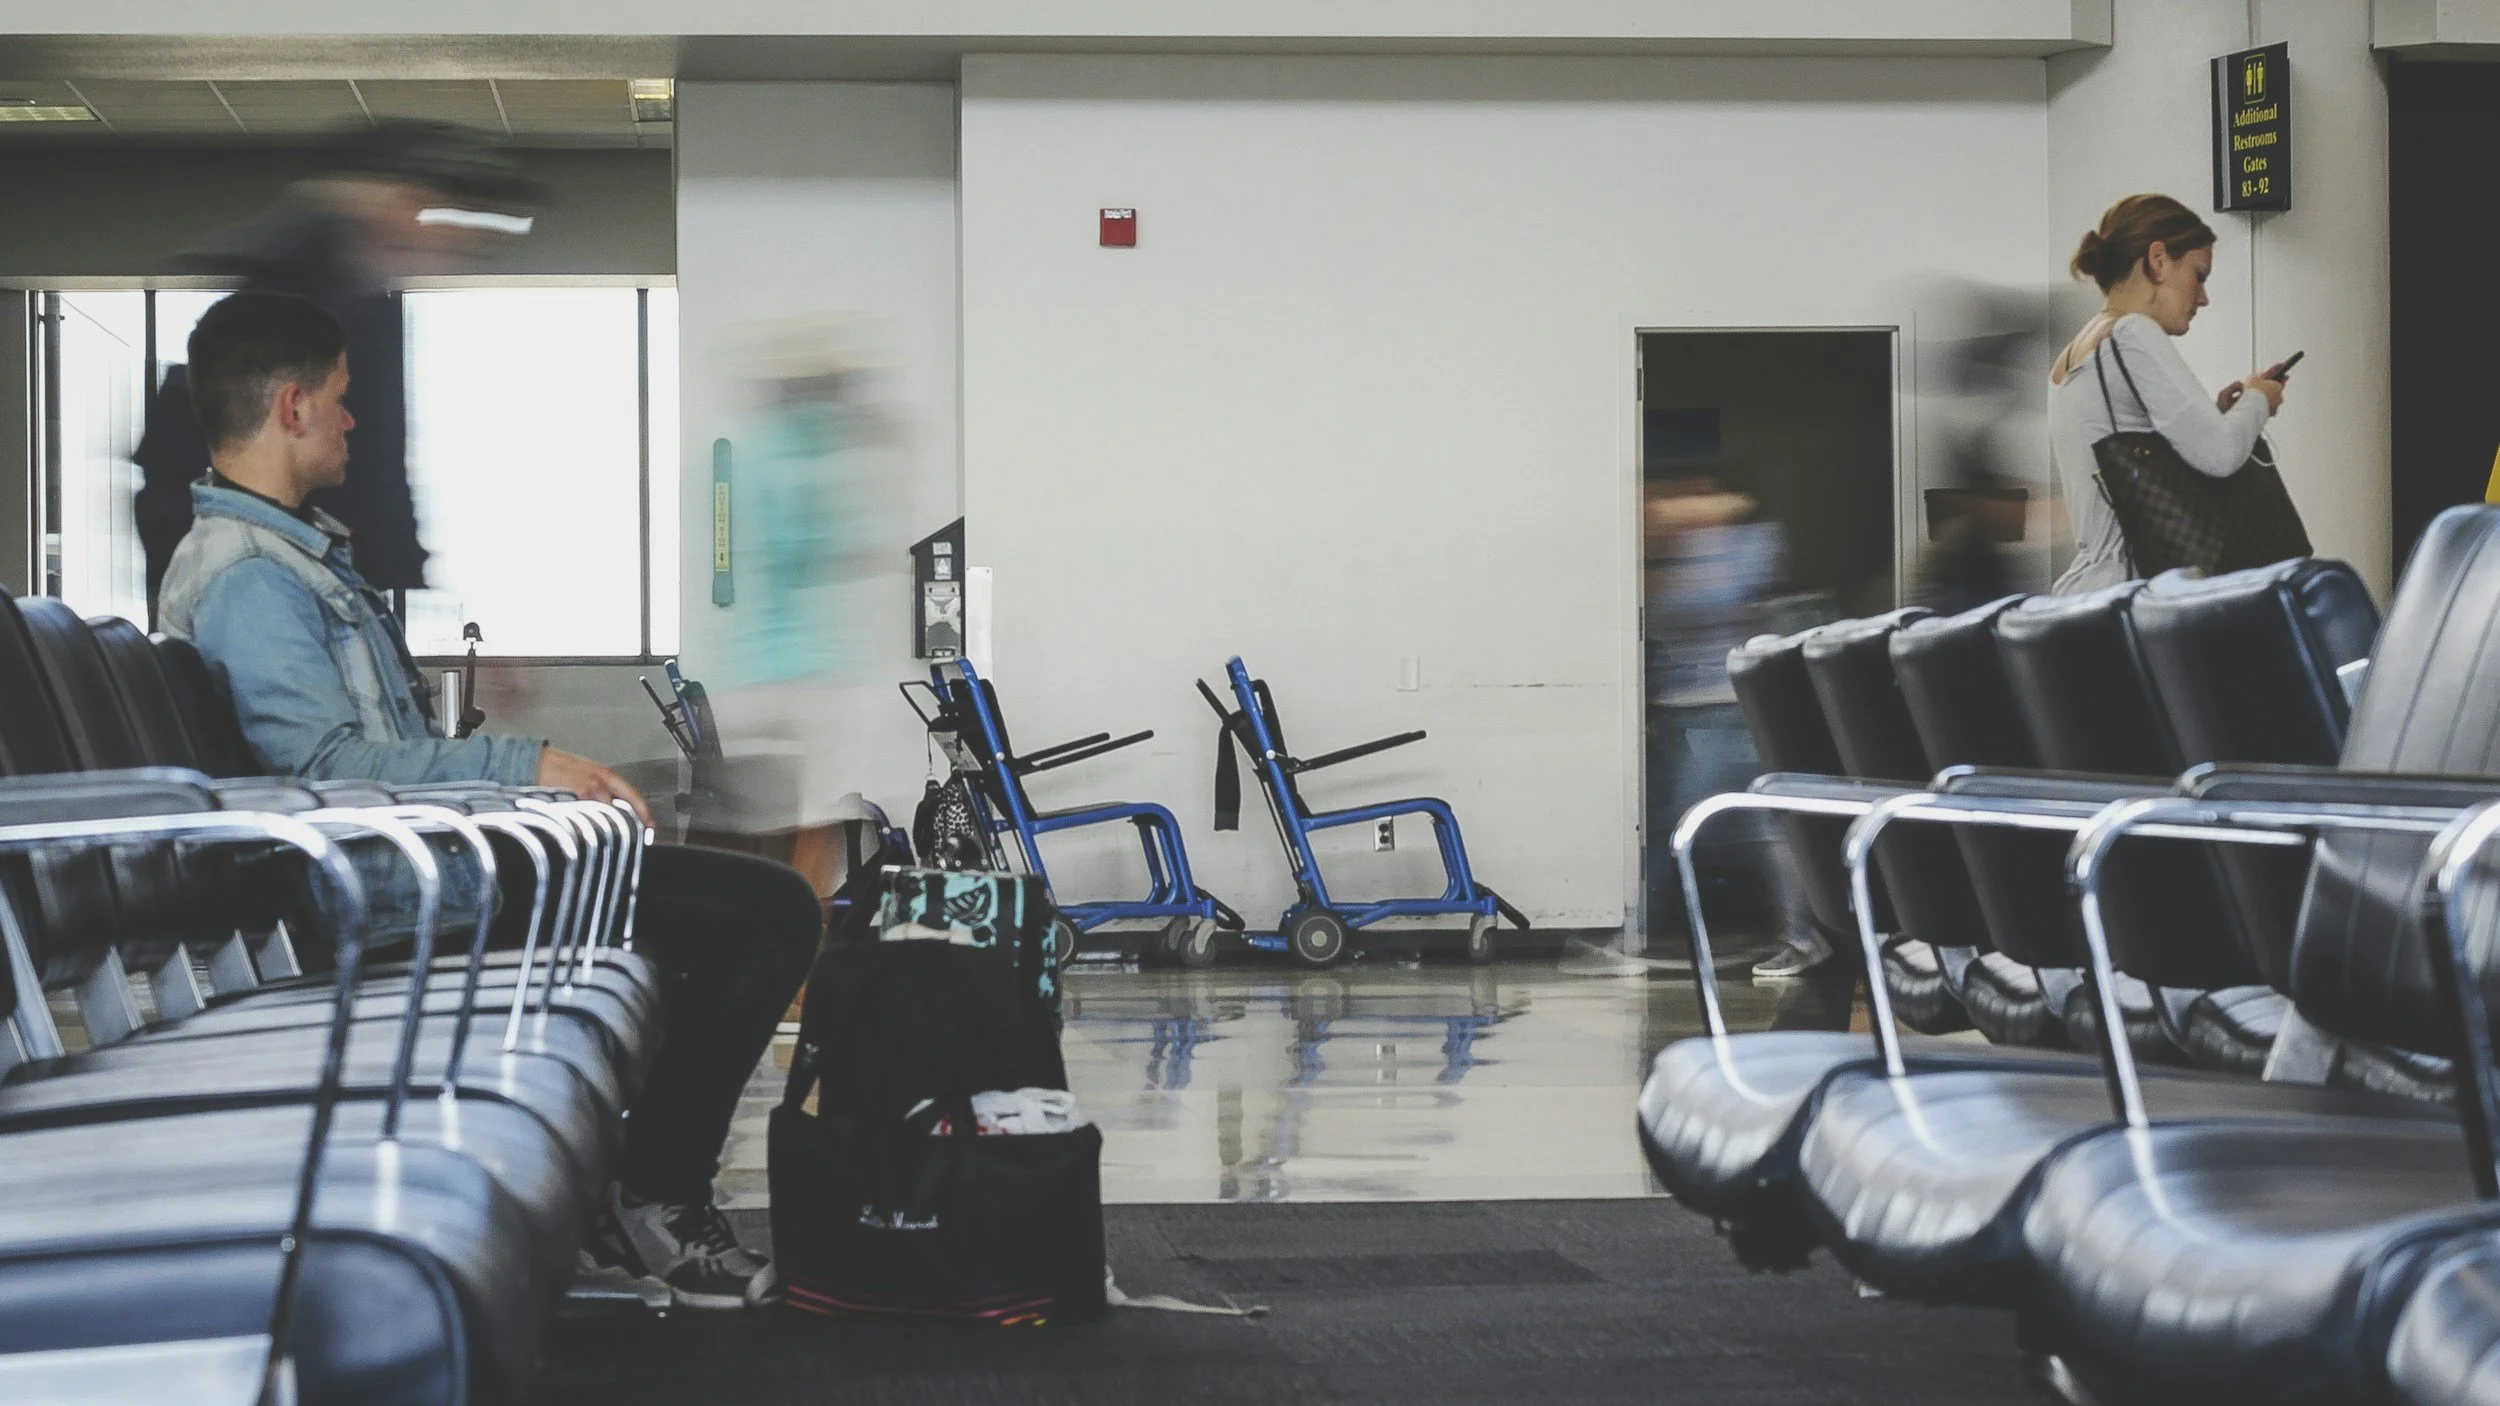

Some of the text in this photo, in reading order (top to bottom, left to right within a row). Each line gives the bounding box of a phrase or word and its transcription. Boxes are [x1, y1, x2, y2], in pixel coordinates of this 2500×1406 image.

[2233, 103, 2278, 128] Additional
[2233, 131, 2277, 152] Restrooms
[2243, 156, 2267, 174] Gates
[2241, 180, 2252, 198] 83
[2258, 177, 2269, 195] 92
